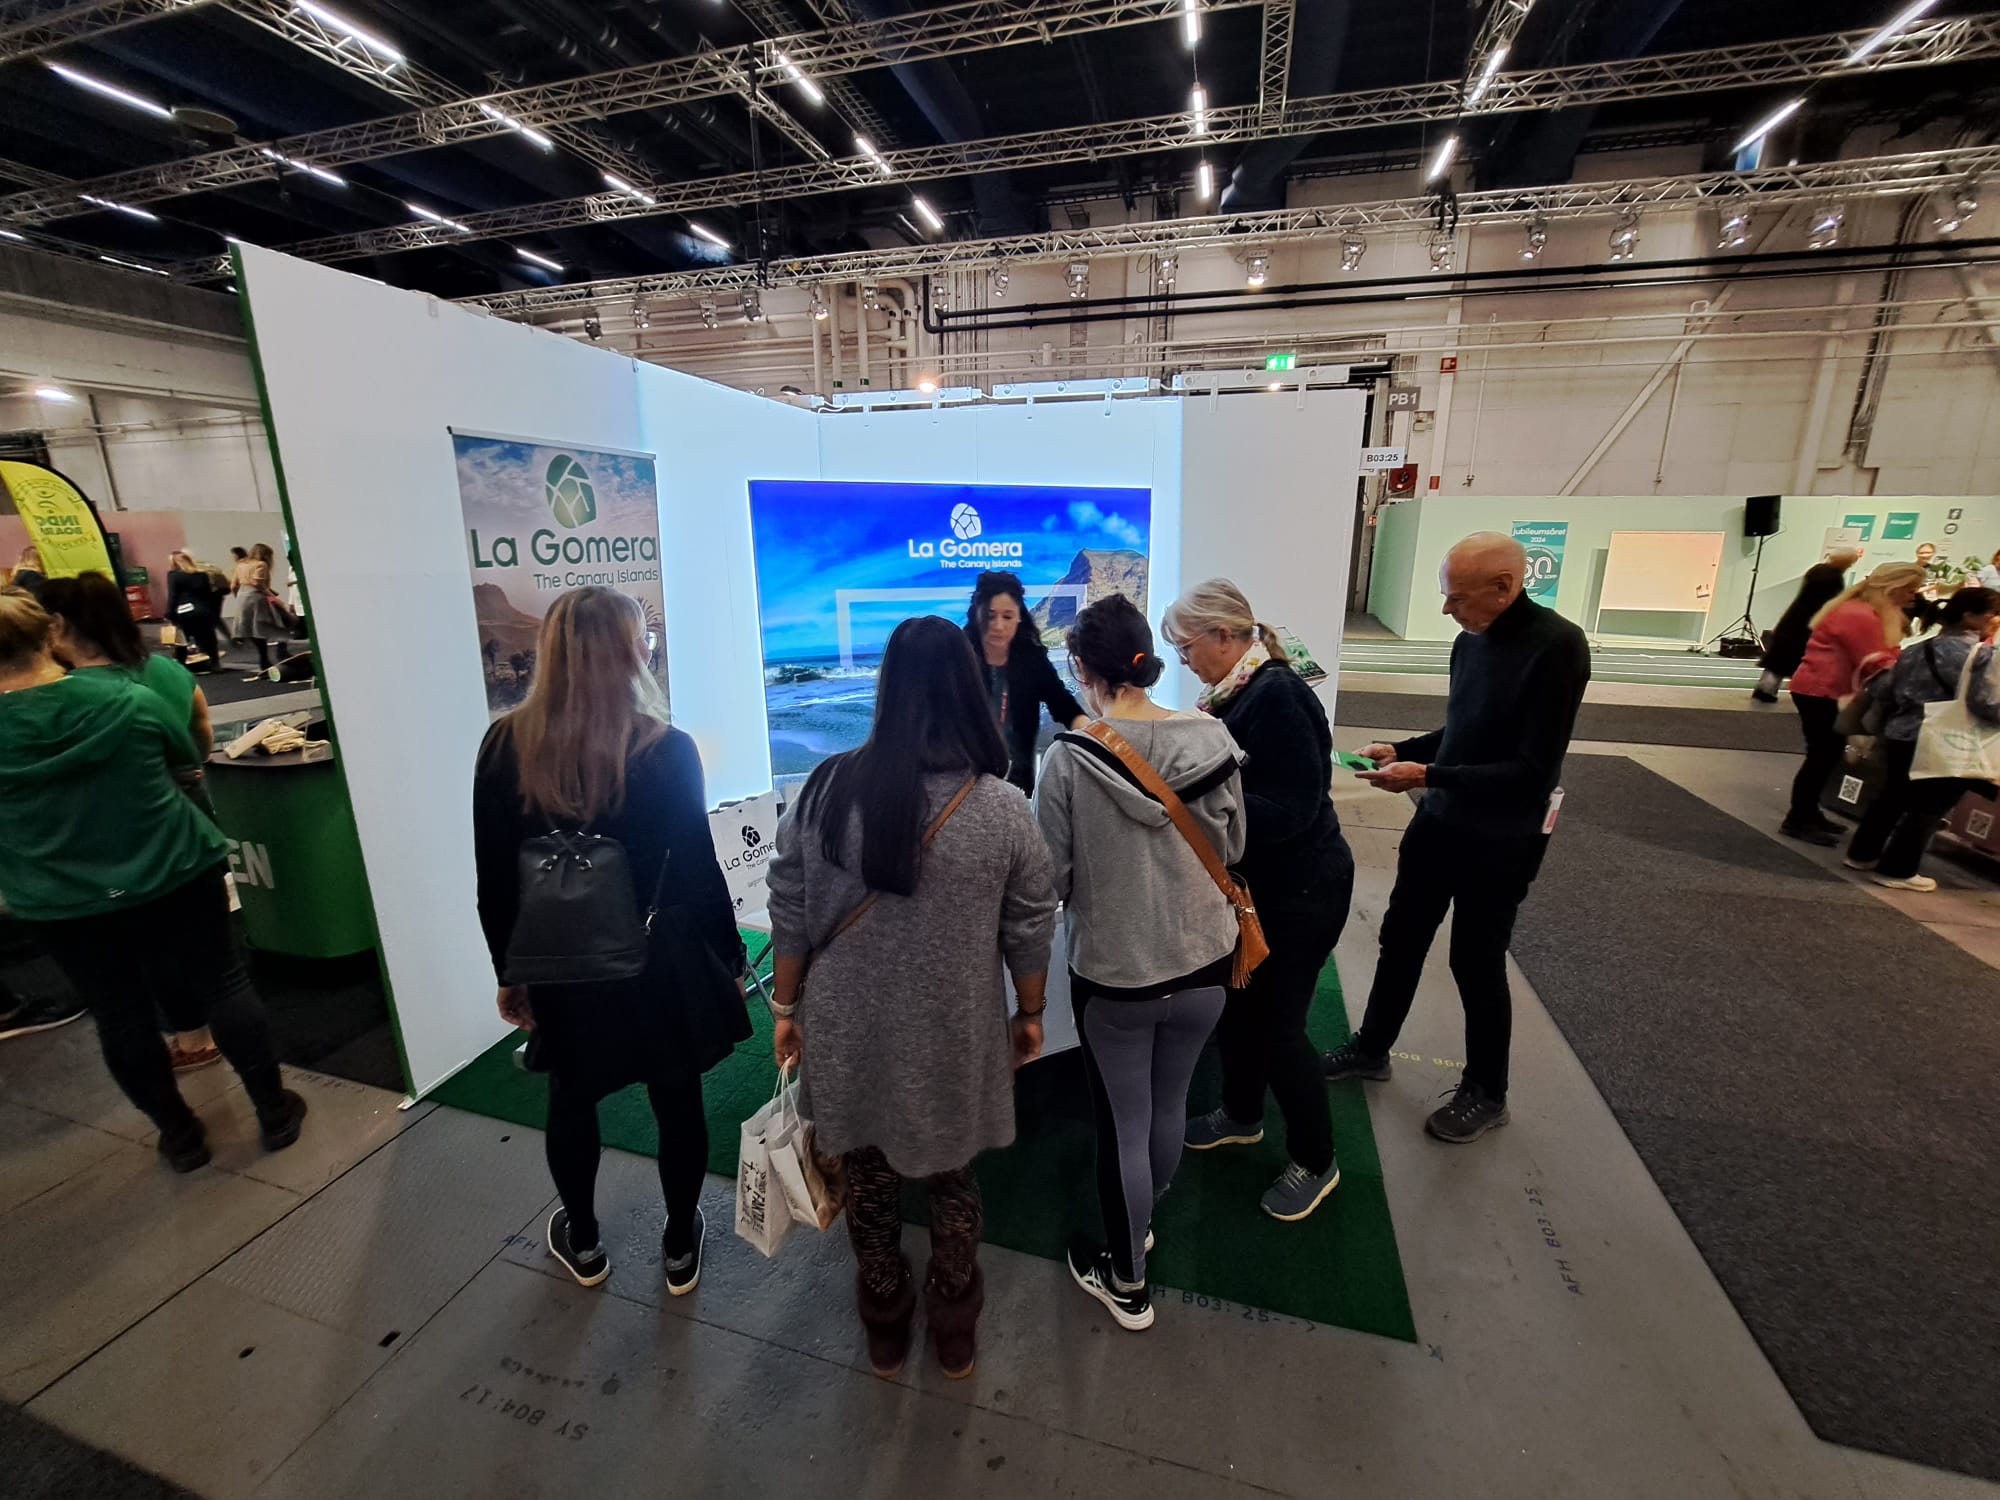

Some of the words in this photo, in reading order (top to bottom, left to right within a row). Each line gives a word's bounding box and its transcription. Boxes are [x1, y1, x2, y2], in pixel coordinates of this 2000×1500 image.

[1388, 392, 1418, 406] PB1
[1366, 453, 1399, 462] B03:25
[470, 528, 519, 568] La
[530, 528, 658, 566] Gomera
[908, 538, 934, 558] La
[939, 538, 1022, 558] Gomera
[940, 559, 957, 568] The
[958, 559, 991, 570] Canary
[991, 559, 1022, 568] Islands
[533, 573, 562, 590] The
[565, 570, 615, 587] Canary
[617, 568, 659, 583] Islands
[724, 857, 741, 871] La
[742, 842, 776, 862] Gome
